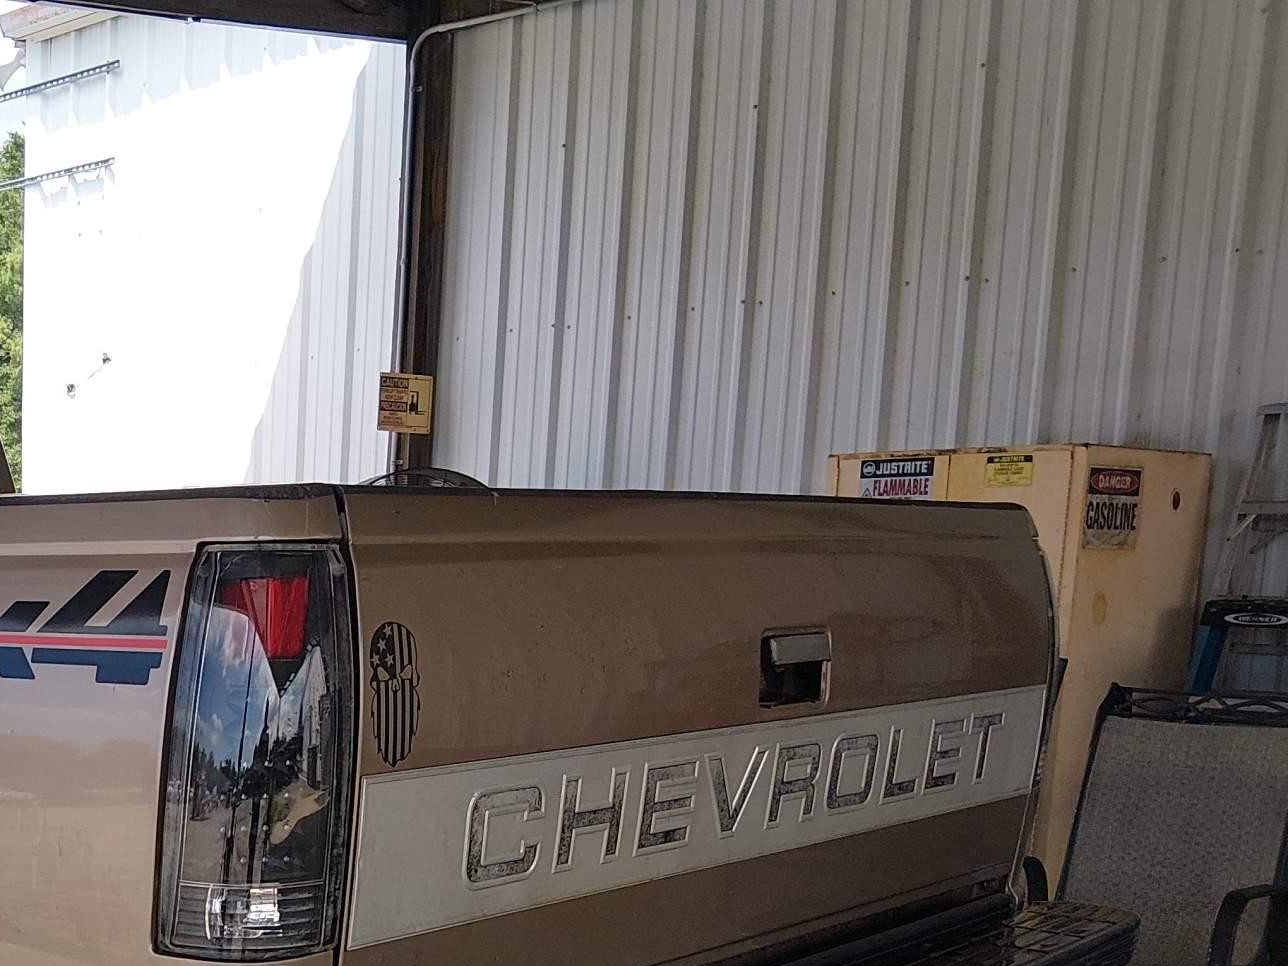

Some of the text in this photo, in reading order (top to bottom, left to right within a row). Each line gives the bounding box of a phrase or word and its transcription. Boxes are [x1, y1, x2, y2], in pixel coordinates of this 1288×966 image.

[381, 378, 409, 388] CAUTION
[875, 461, 928, 475] JUSTRITE
[873, 477, 930, 497] FLAMMABLE
[1098, 474, 1132, 489] DANGER
[1086, 501, 1138, 531] GASOLINE
[462, 710, 1006, 891] CHEVROLET
